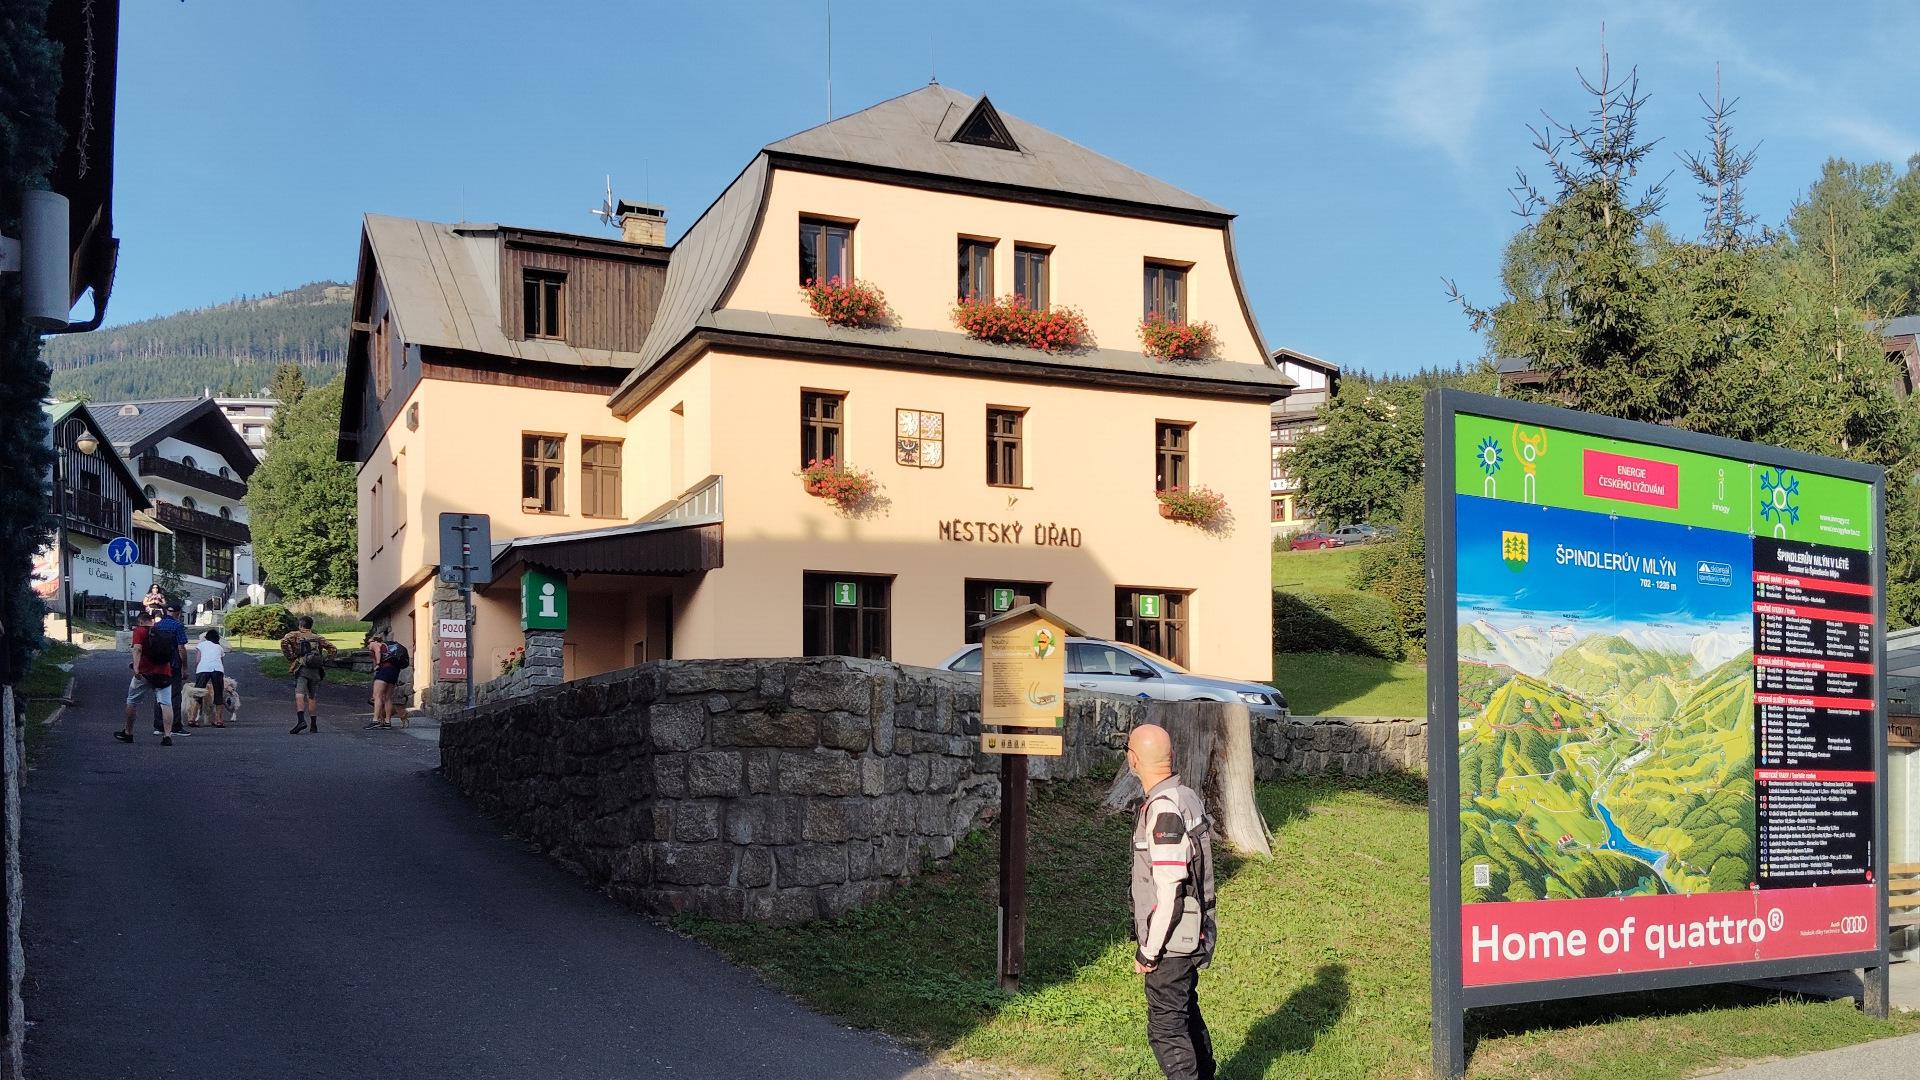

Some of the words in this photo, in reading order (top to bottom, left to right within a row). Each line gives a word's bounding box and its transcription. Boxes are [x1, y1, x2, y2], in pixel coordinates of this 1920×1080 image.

[1617, 465, 1647, 479] ENERGIE
[1598, 474, 1632, 491] ČESKÉHO
[1632, 481, 1665, 496] LYŽOVÁNÍ
[1712, 503, 1730, 514] innogy
[938, 518, 1023, 545] MĚSTSKÝ
[1555, 543, 1640, 573] ŠPINDLERŮV
[1642, 556, 1677, 577] MLÝN
[442, 623, 467, 633] POZO
[452, 659, 460, 667] A
[446, 667, 466, 675] LED!
[1471, 923, 1587, 963] Home
[1597, 916, 1636, 955] of
